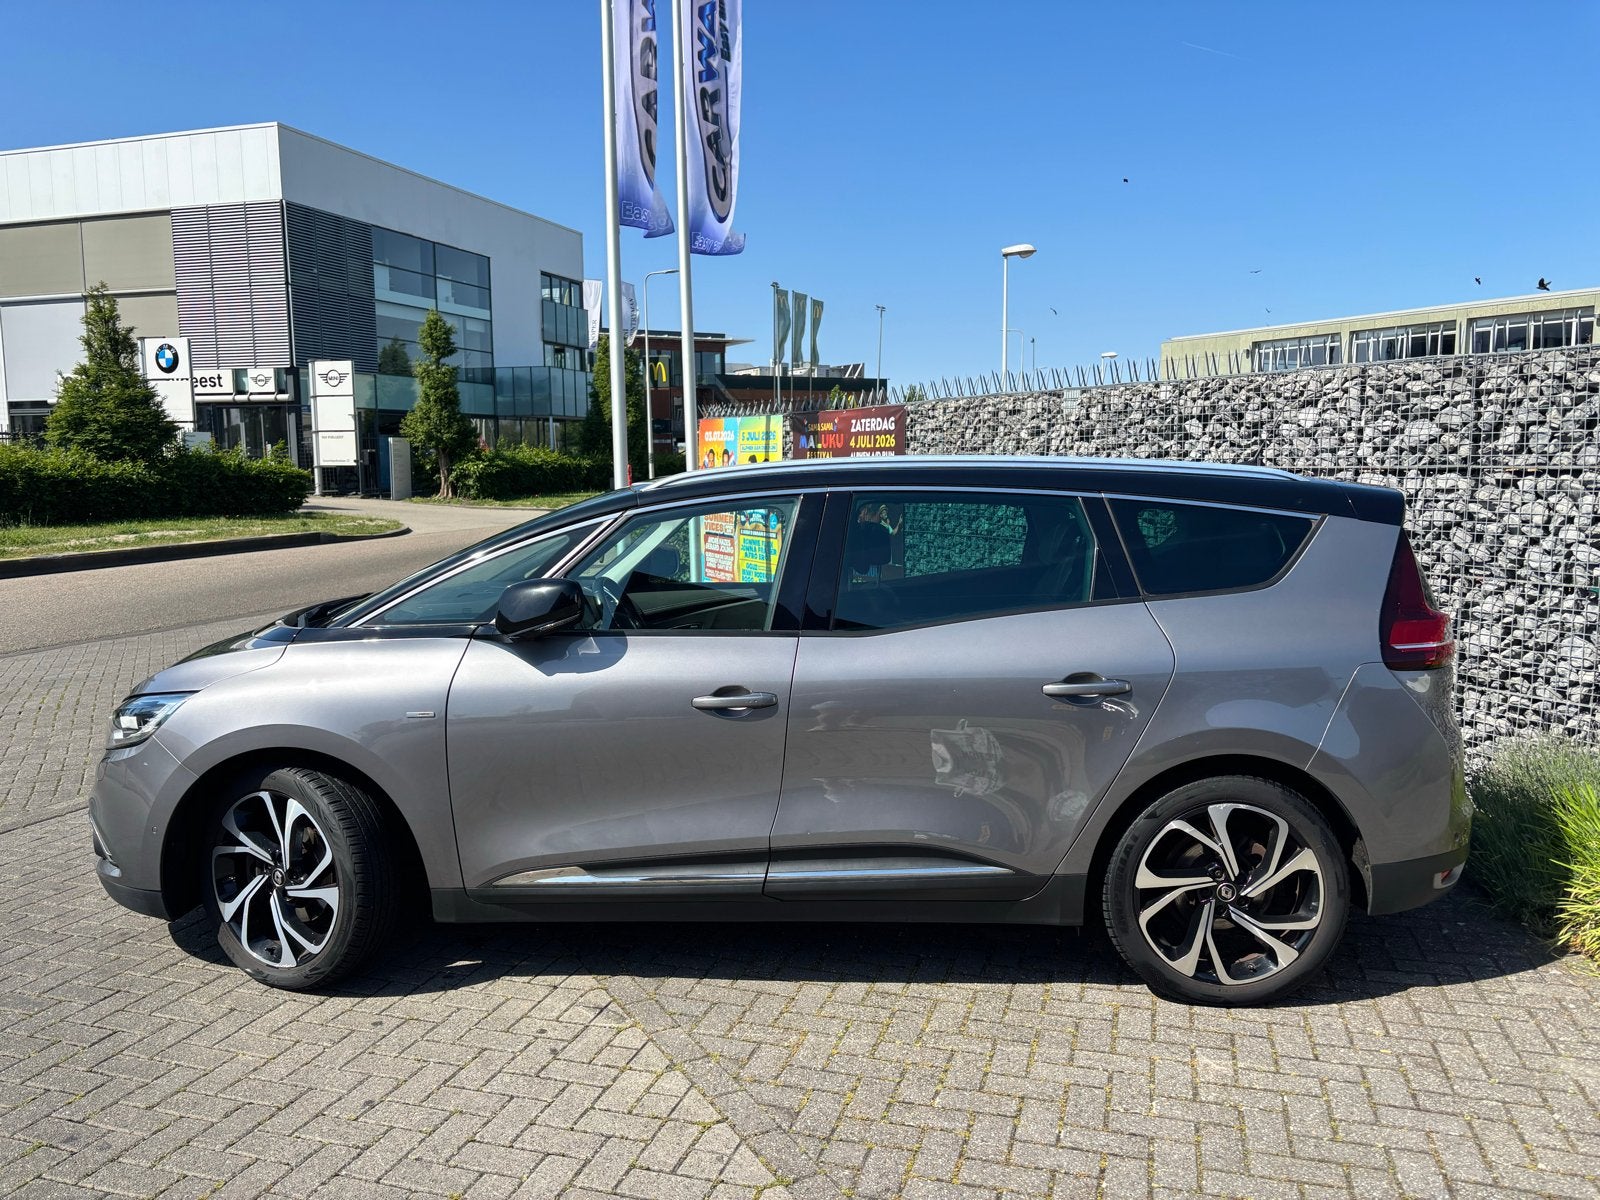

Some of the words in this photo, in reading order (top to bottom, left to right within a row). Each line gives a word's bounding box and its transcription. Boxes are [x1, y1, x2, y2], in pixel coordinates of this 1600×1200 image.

[820, 422, 833, 431] SAMA
[850, 416, 895, 432] ZATERDAG
[799, 433, 844, 448] MALUKU
[849, 435, 855, 448] 4
[856, 435, 874, 448] JULI
[875, 434, 896, 447] 2026
